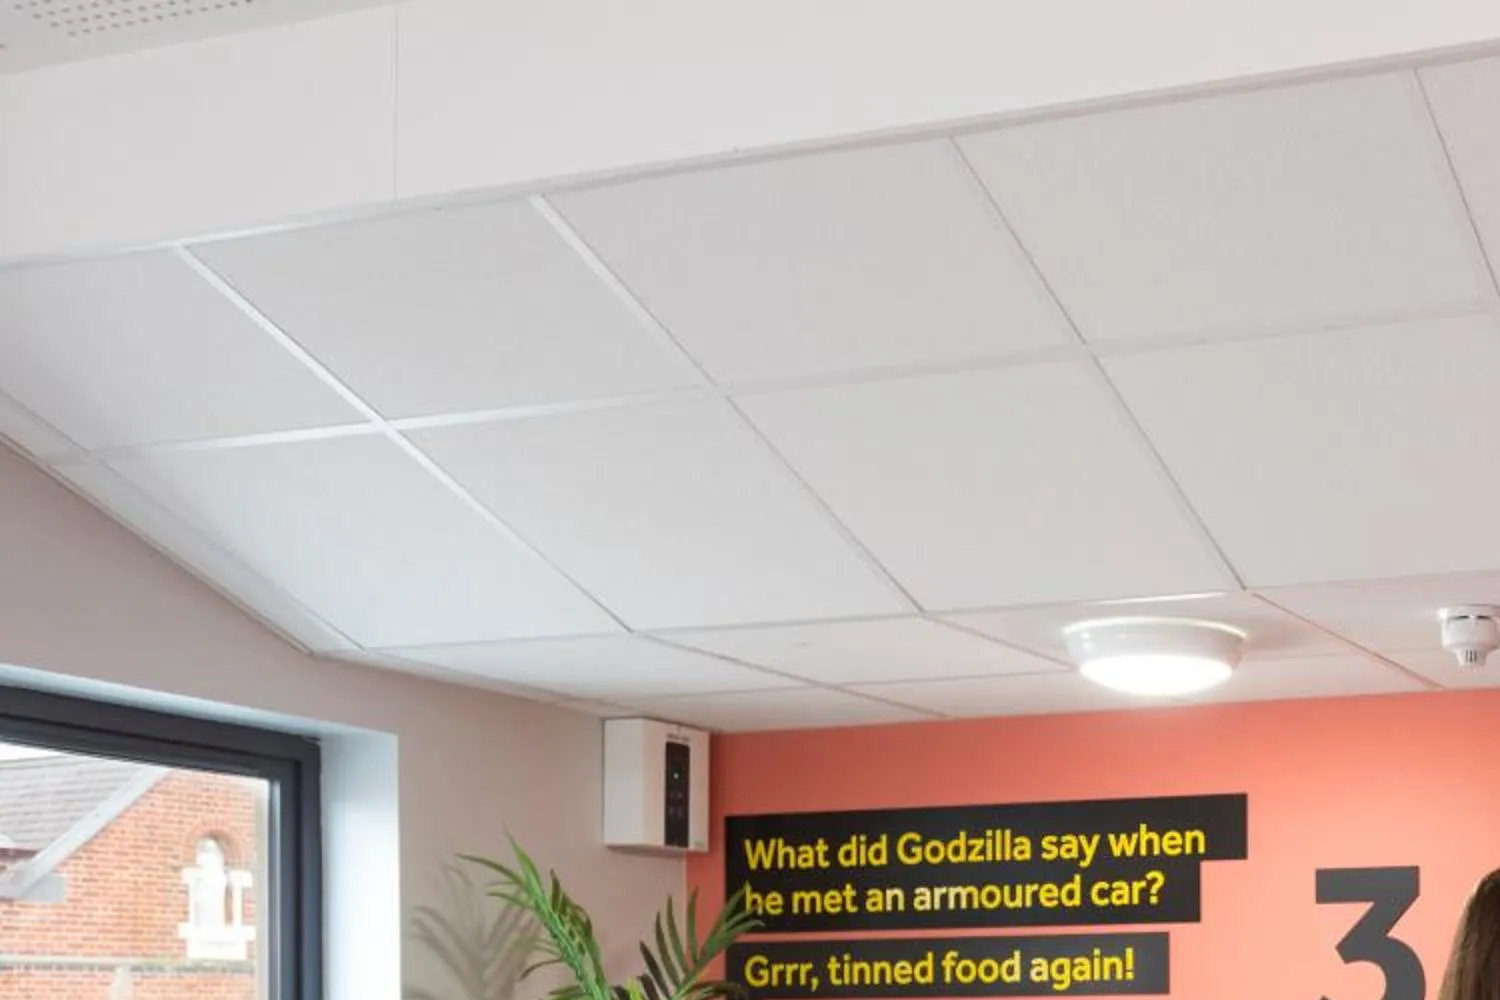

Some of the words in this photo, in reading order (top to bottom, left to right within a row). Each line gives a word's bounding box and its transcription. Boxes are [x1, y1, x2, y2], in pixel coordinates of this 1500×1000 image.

[744, 837, 831, 870] What
[838, 833, 888, 868] did
[897, 828, 1032, 865] Godzilla
[1041, 832, 1100, 868] say
[1108, 823, 1205, 857] when
[744, 881, 784, 915] he
[791, 883, 858, 914] met
[865, 886, 905, 913] an
[913, 873, 1082, 912] armoured
[1091, 870, 1166, 907] car?
[744, 954, 820, 993] Grrr,
[827, 951, 934, 987] tinned
[942, 949, 1021, 984] food
[1029, 947, 1134, 991] again!
